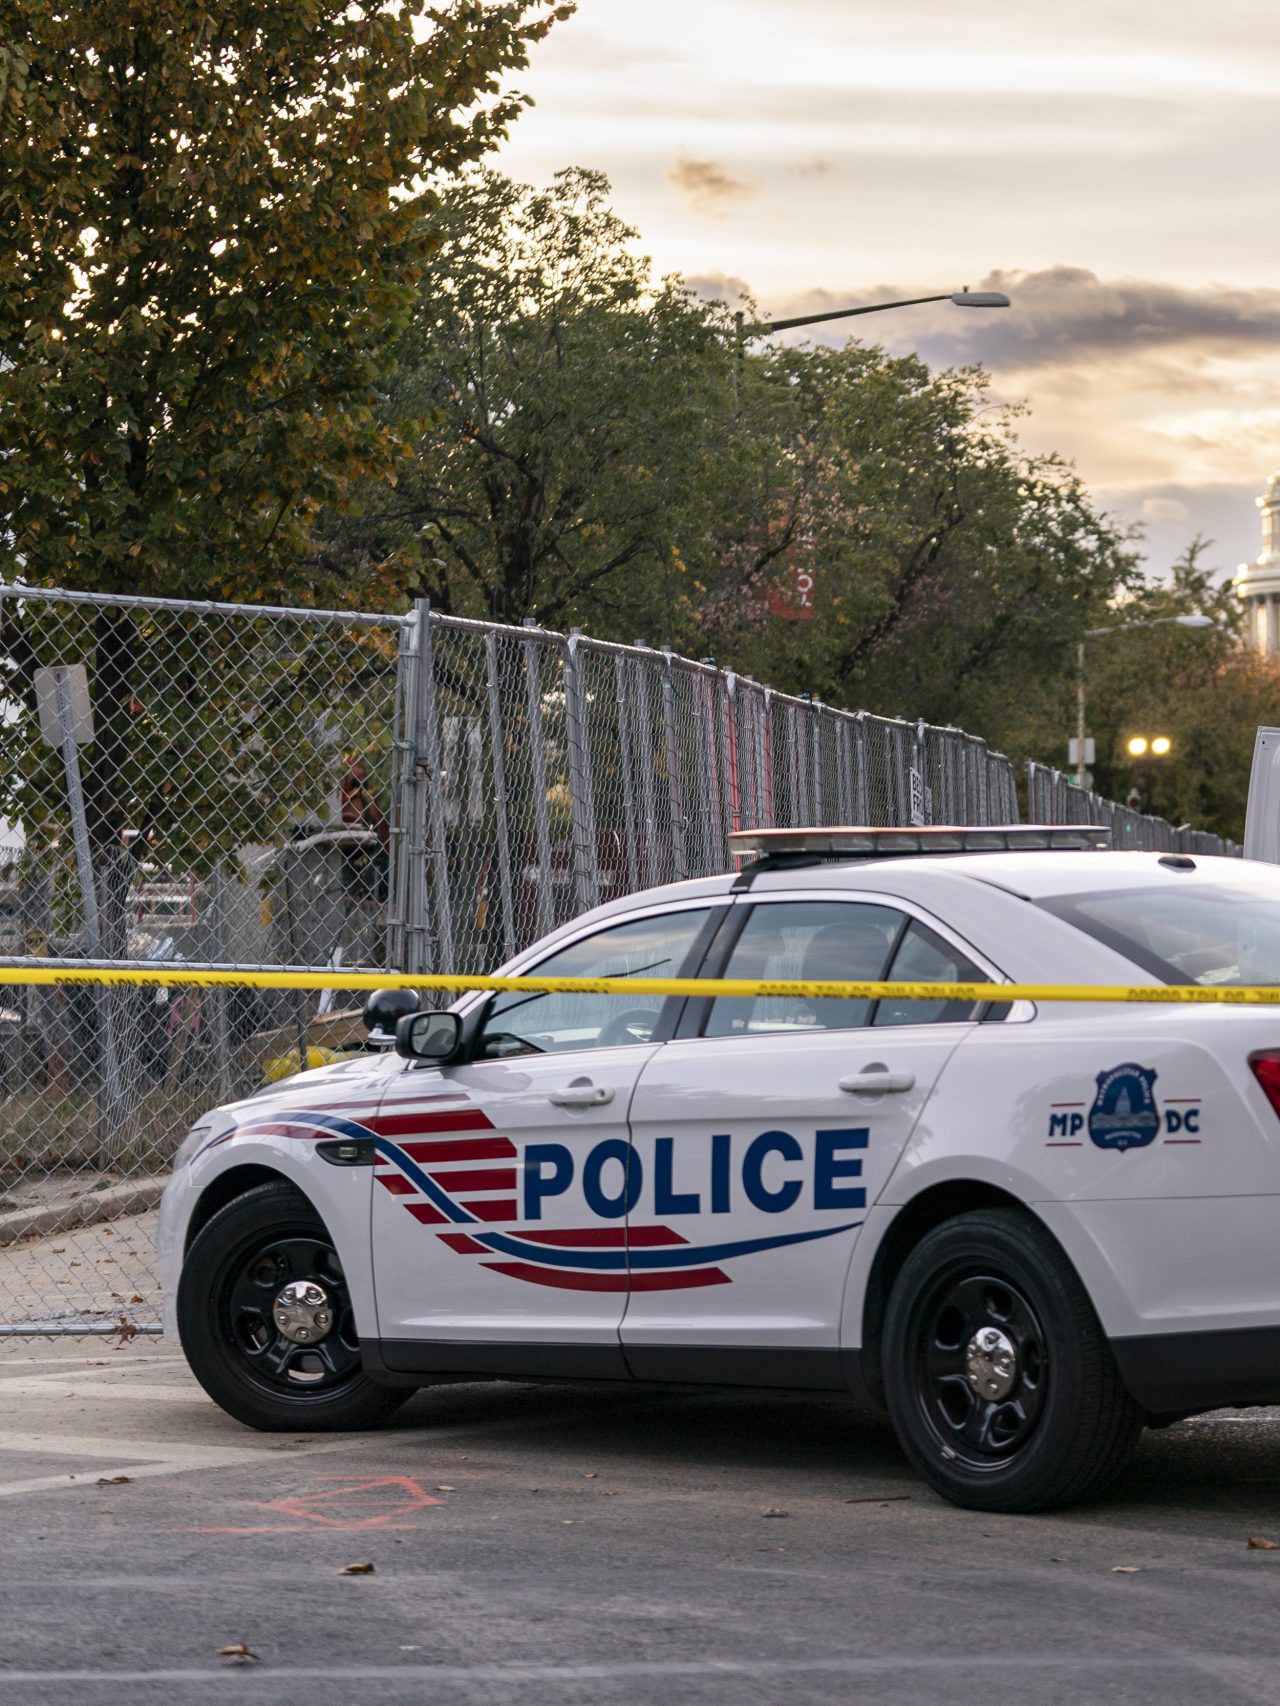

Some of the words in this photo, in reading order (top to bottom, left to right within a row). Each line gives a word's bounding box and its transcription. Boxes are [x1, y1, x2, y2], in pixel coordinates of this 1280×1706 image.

[1048, 1113, 1084, 1137] MP
[1165, 1109, 1200, 1133] DC
[523, 1128, 870, 1220] POLICE
